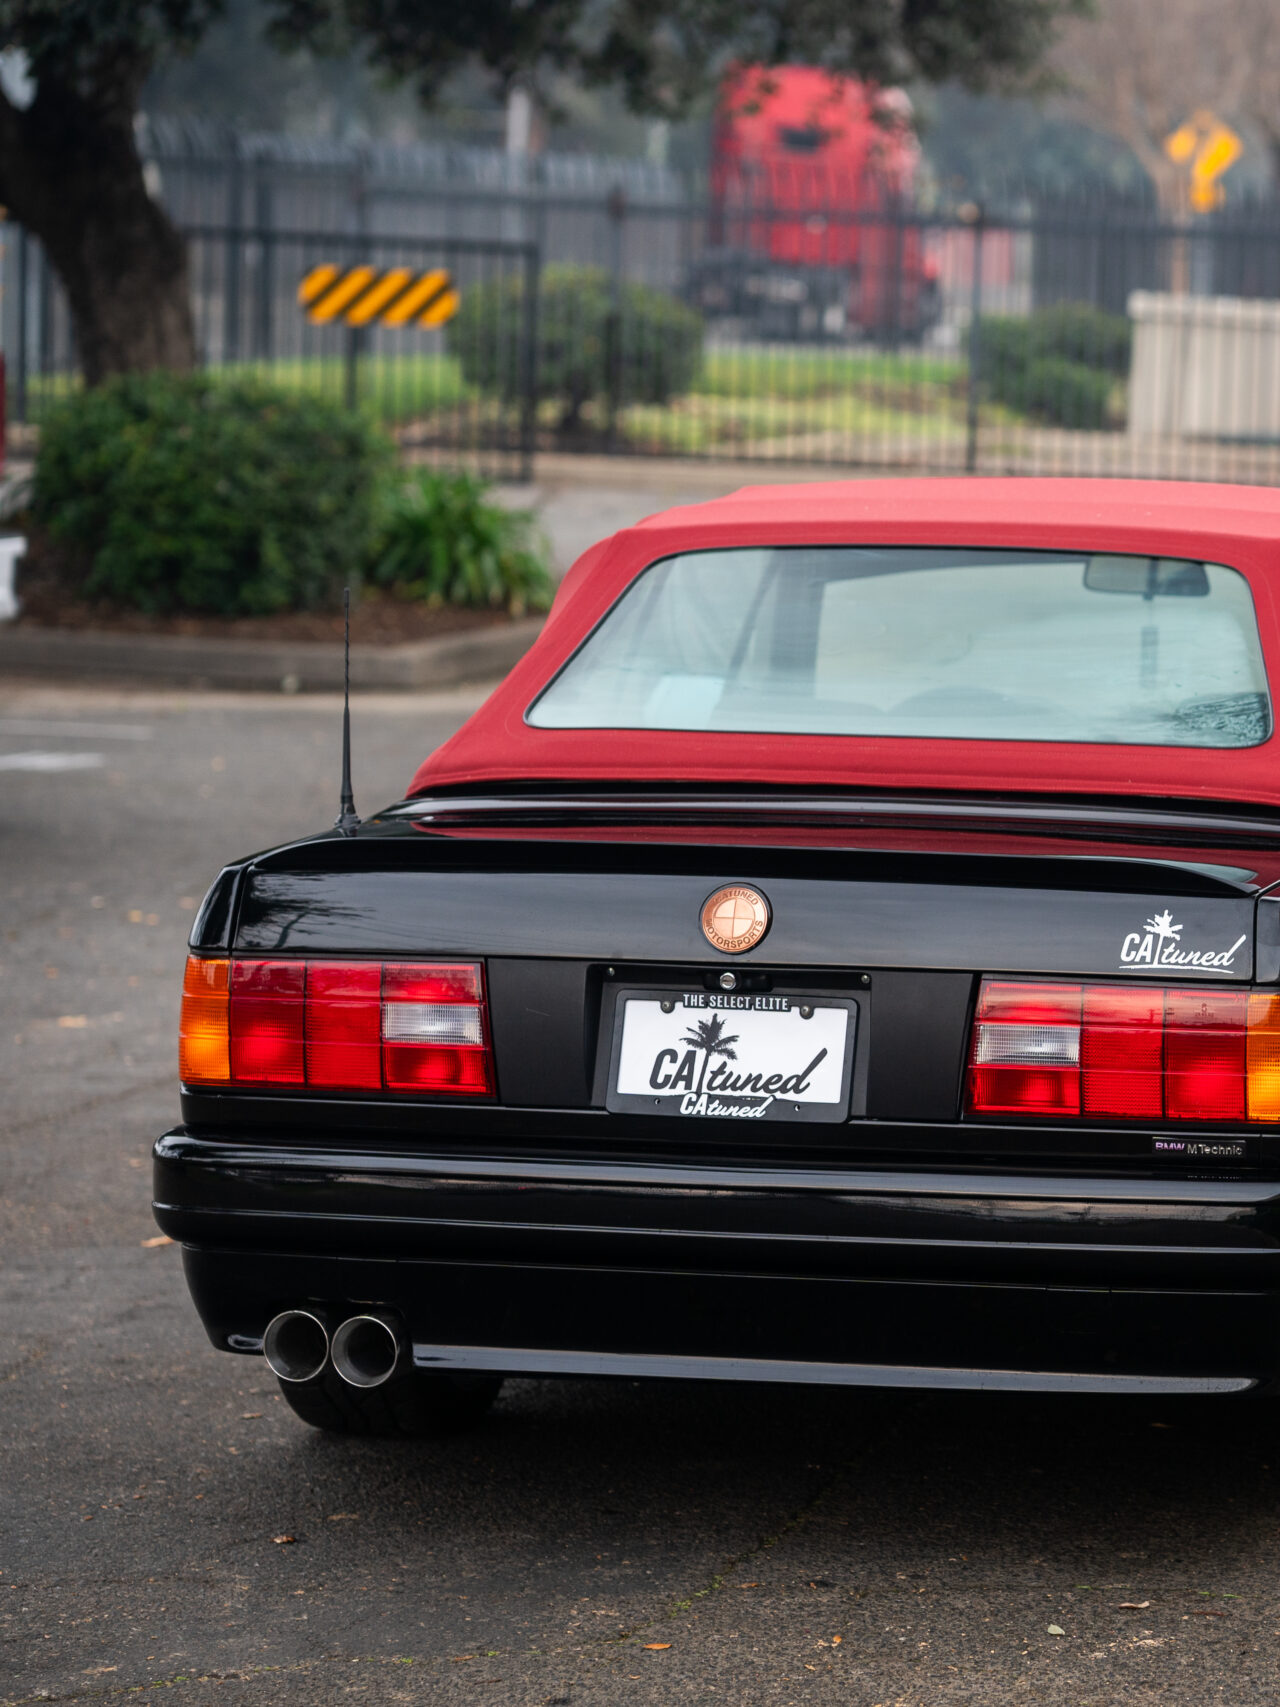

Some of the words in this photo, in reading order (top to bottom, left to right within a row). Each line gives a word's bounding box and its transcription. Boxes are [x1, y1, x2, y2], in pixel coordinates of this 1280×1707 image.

[705, 919, 763, 949] MOTORSPORTS
[683, 993, 705, 1007] THE
[709, 995, 751, 1009] SELECT
[755, 997, 789, 1011] ELITE
[1155, 1142, 1185, 1151] BMW
